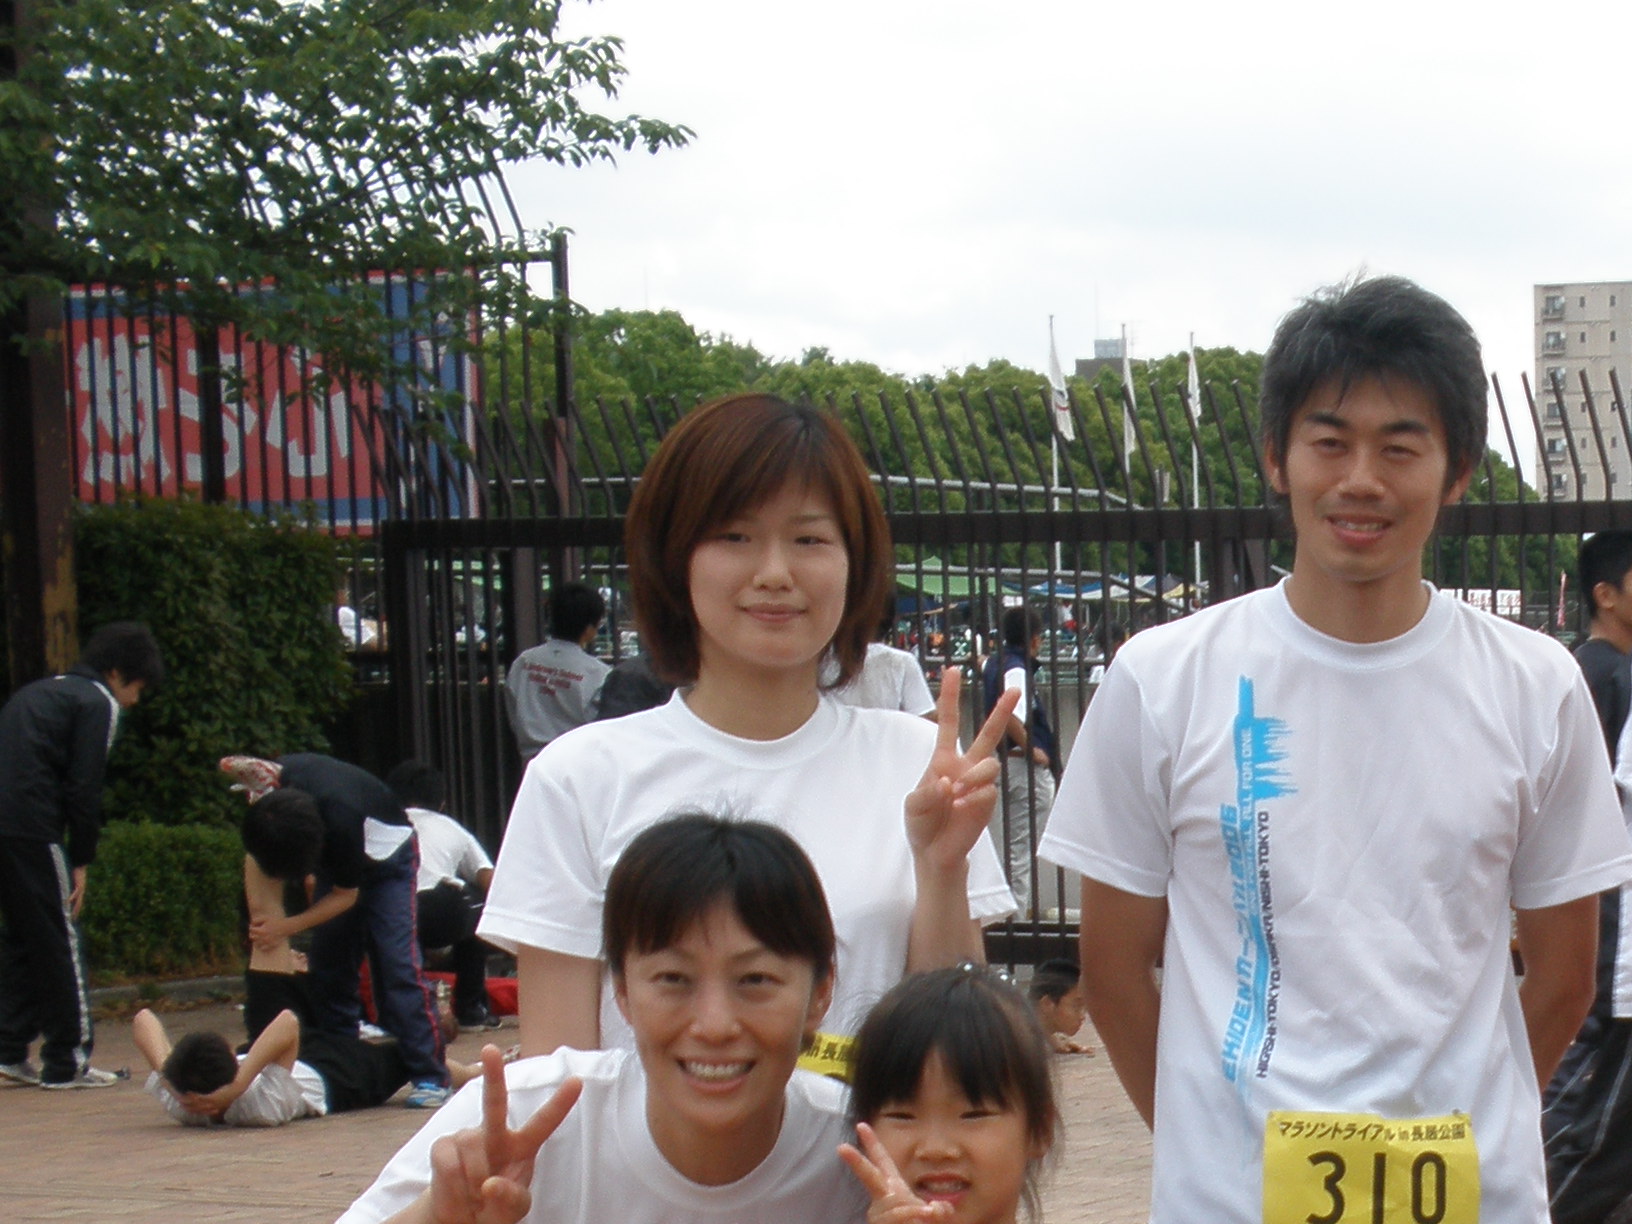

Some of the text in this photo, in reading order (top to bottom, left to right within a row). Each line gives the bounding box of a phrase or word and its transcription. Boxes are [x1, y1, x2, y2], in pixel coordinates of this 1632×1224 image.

[1241, 761, 1253, 790] FOR
[1241, 794, 1253, 820] ALL
[1279, 1119, 1397, 1143] マラソントライアル
[1411, 1122, 1466, 1143] 長居公園
